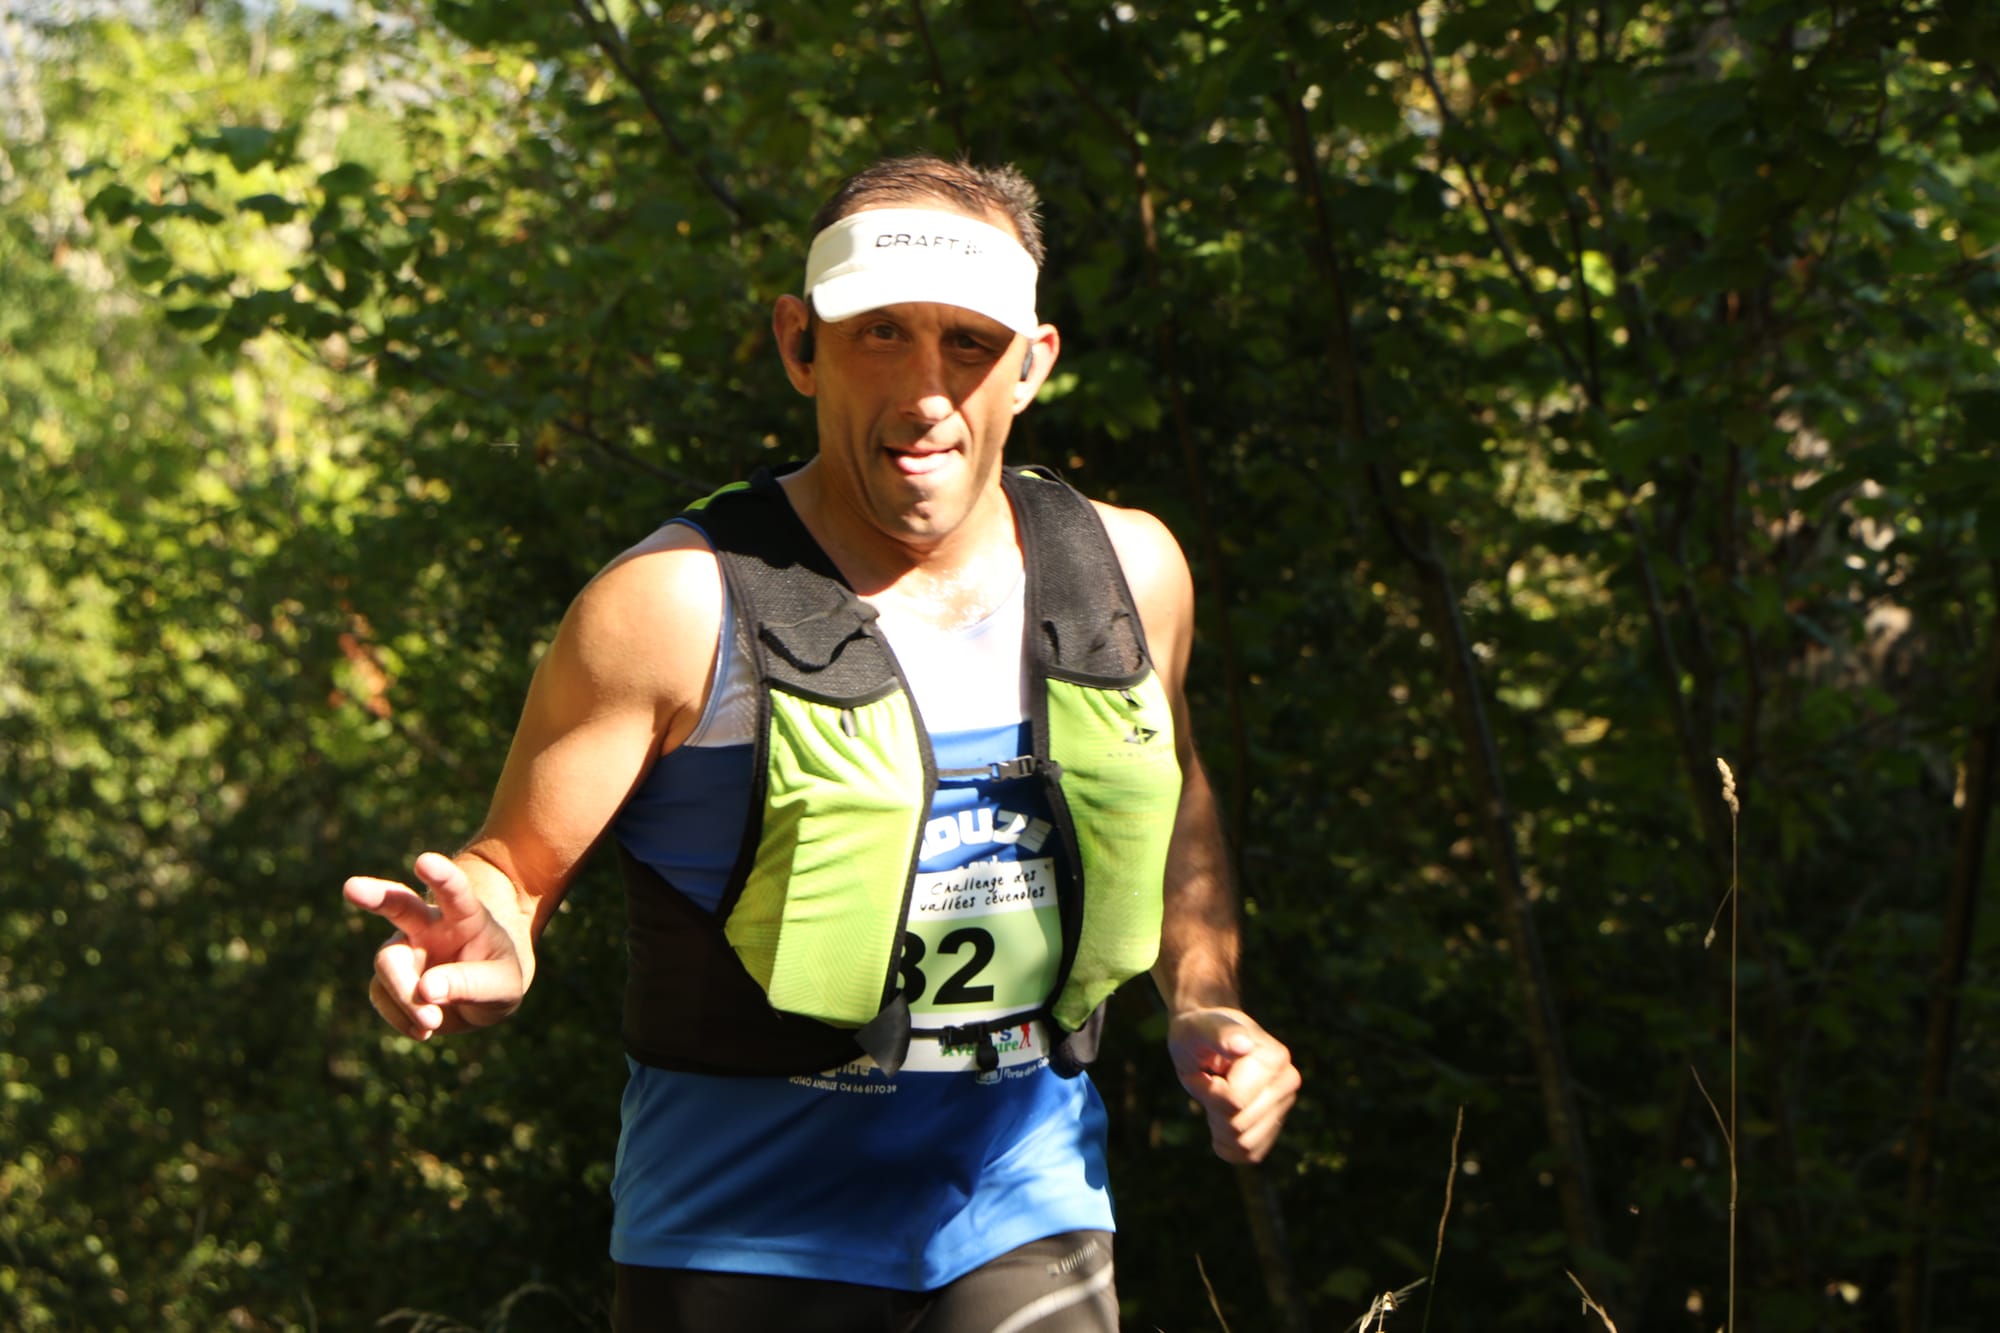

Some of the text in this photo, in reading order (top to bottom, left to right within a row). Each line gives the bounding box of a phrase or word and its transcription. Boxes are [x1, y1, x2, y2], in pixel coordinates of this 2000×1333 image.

[874, 233, 960, 250] CRAFT
[930, 869, 1037, 896] Challenge des
[920, 886, 1046, 912] vallées cévenoles
